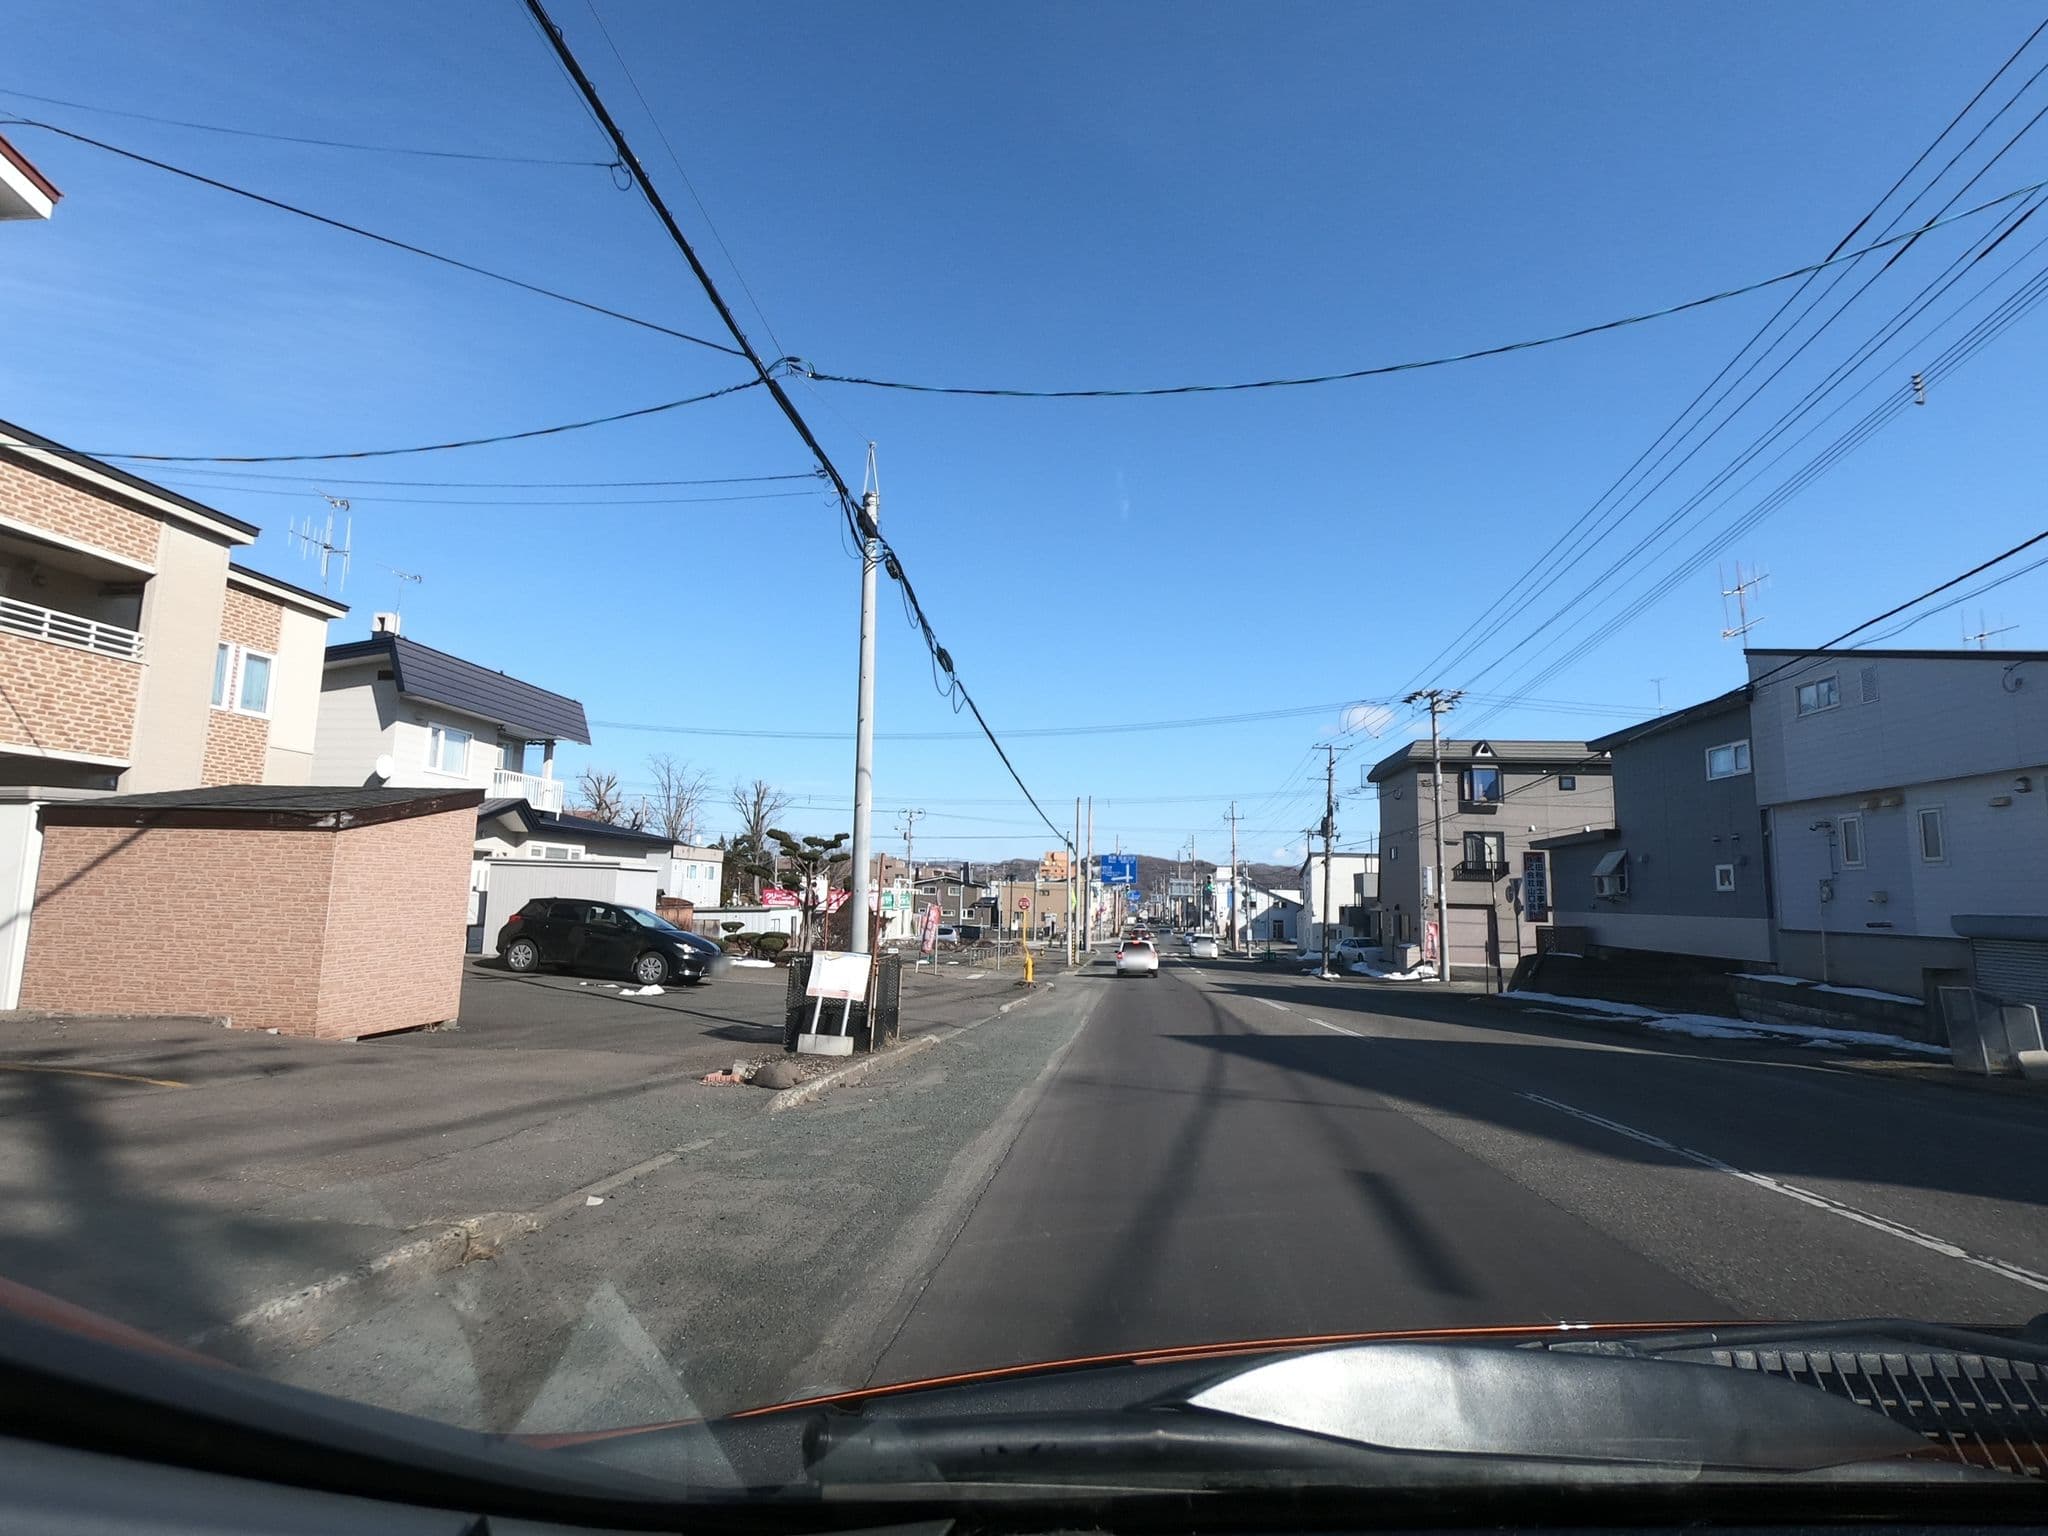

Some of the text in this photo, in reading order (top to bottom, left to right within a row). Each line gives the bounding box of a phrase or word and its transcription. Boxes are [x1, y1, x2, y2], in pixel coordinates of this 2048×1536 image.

[765, 892, 797, 900] クリーニン
